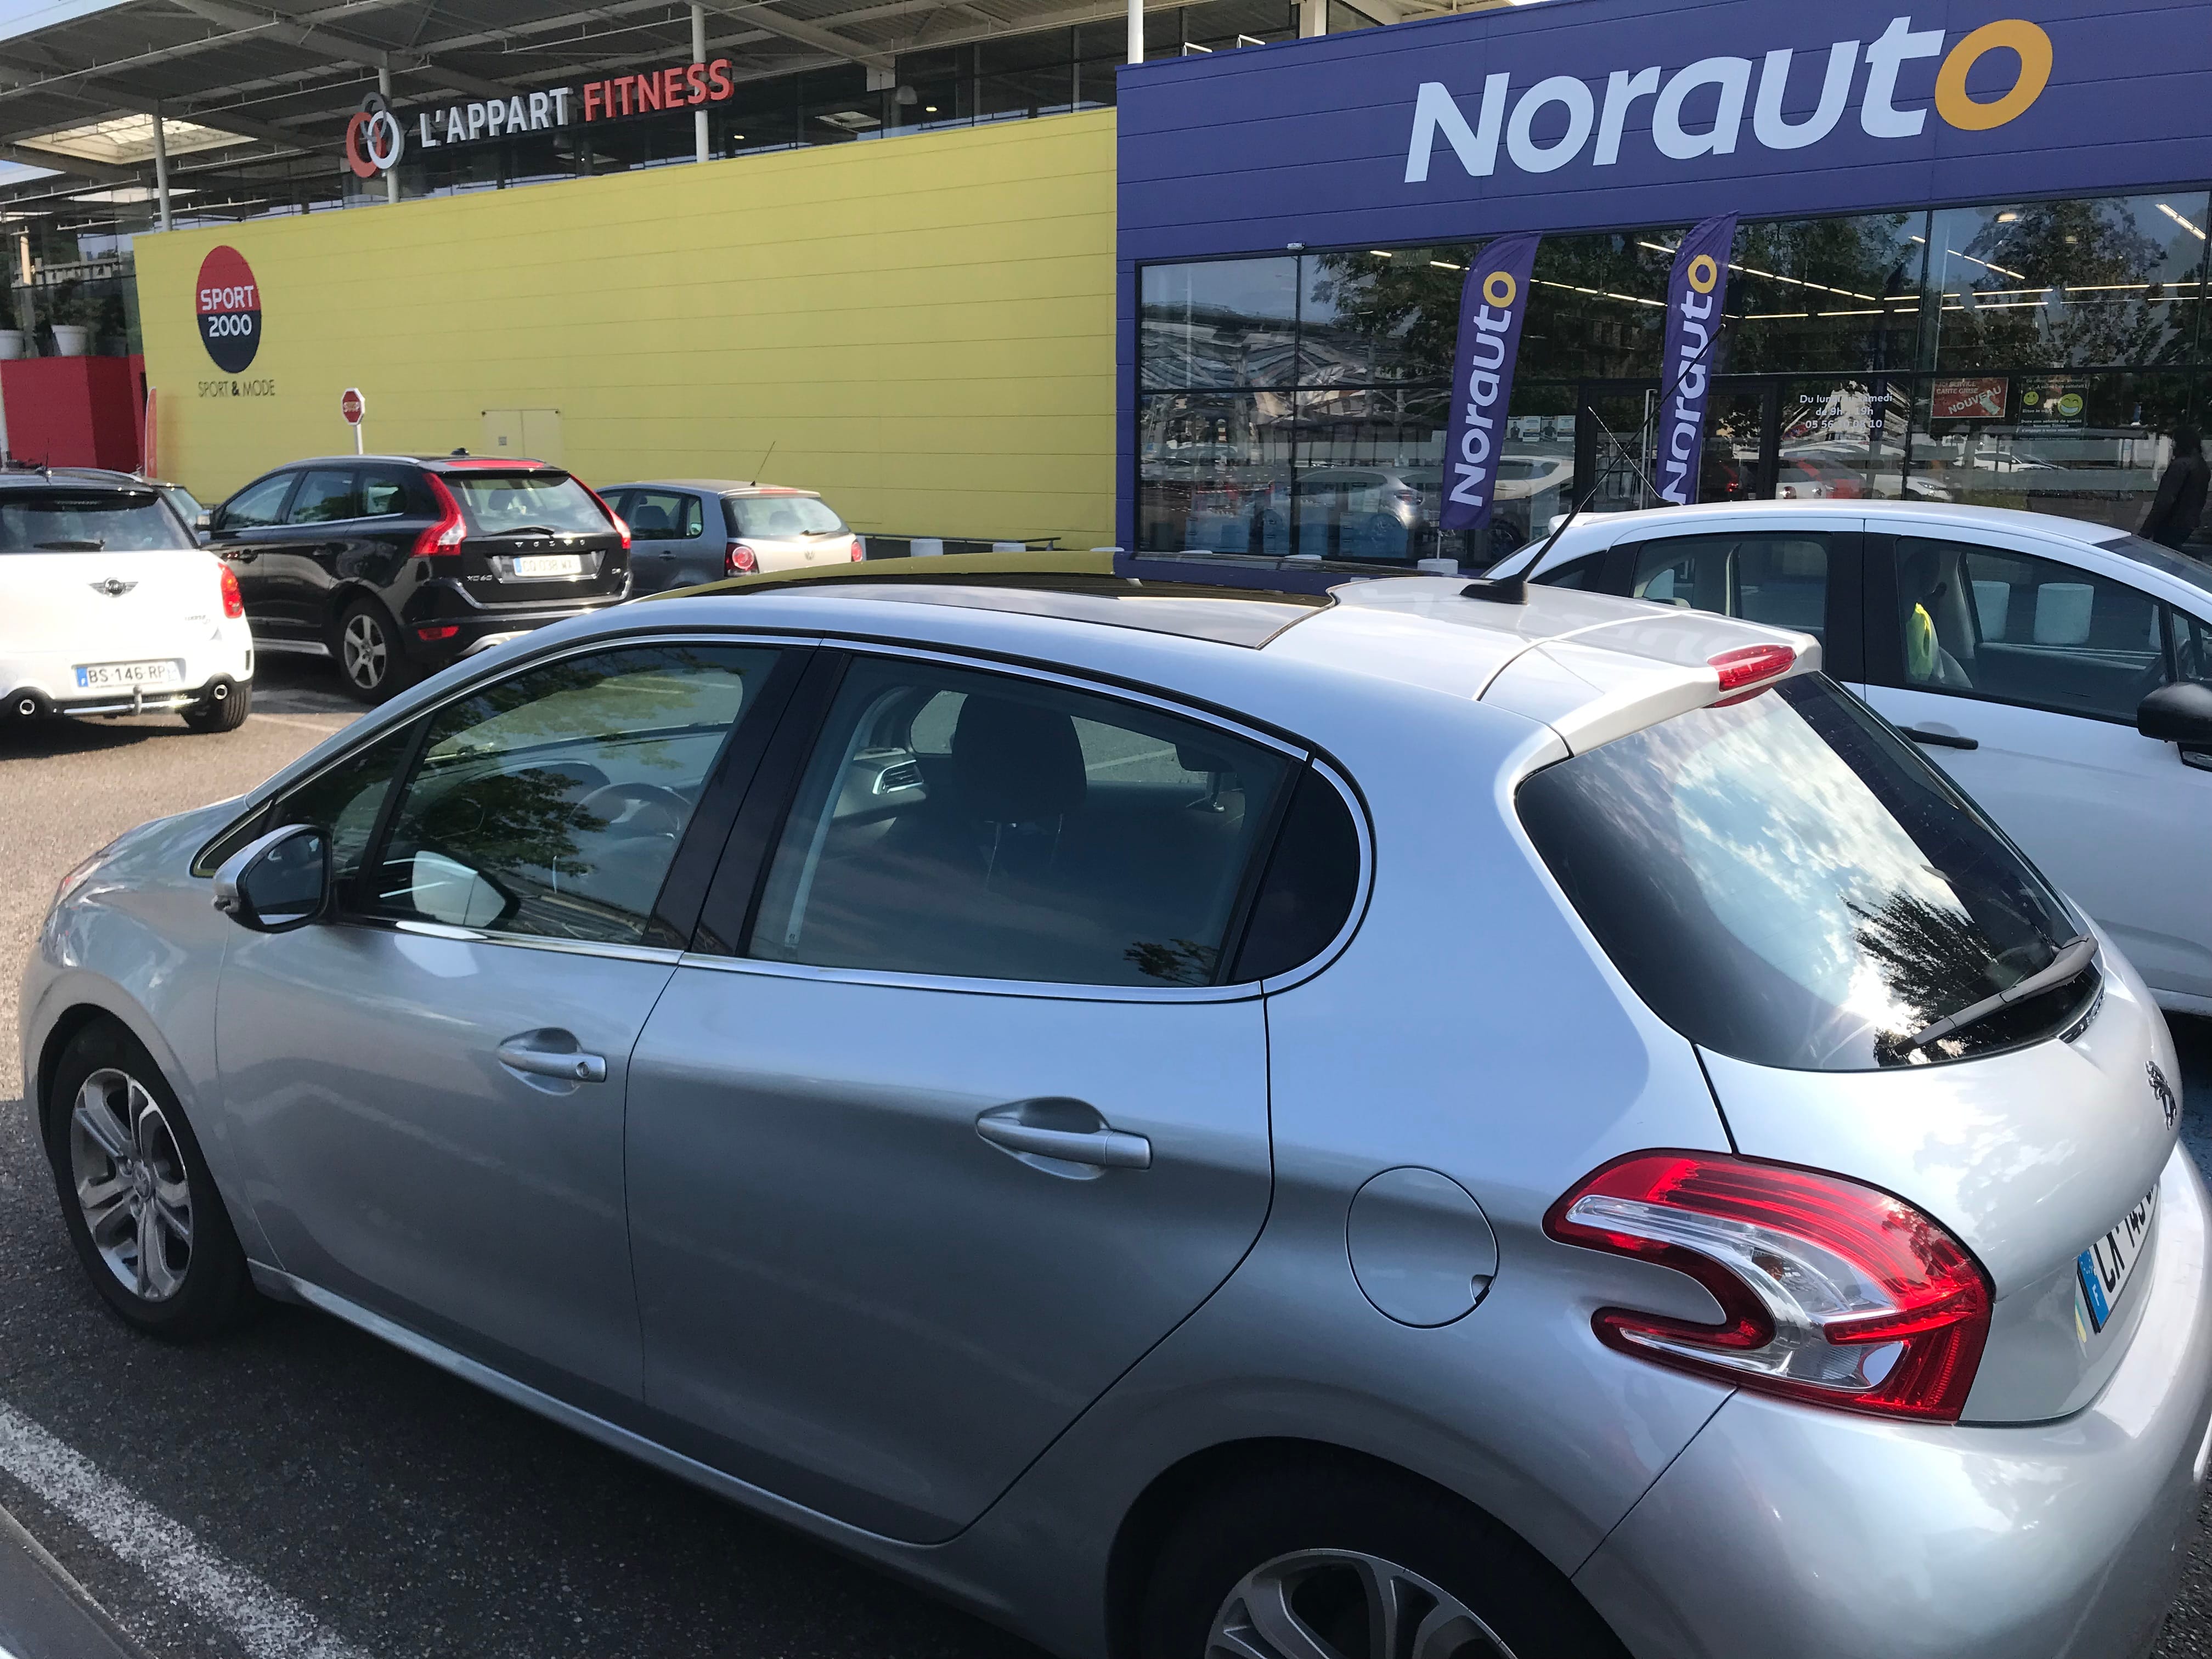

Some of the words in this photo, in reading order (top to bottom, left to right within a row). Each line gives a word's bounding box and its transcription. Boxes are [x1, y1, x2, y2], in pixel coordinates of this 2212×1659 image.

[419, 87, 574, 148] L'APPART
[584, 59, 735, 122] FITNESS
[1404, 16, 2053, 183] Norauto
[200, 285, 254, 311] SPORT
[208, 314, 252, 338] 2000
[198, 381, 229, 397] SPORT
[243, 379, 275, 397] MODE
[1449, 272, 1516, 507] Norauto
[1662, 255, 1717, 505] Norauto
[1799, 394, 1814, 403] Du
[1830, 407, 1843, 416] 9h
[1948, 385, 2002, 414] NOUVEAU
[1805, 420, 1818, 428] 05
[1870, 419, 1882, 428] 10
